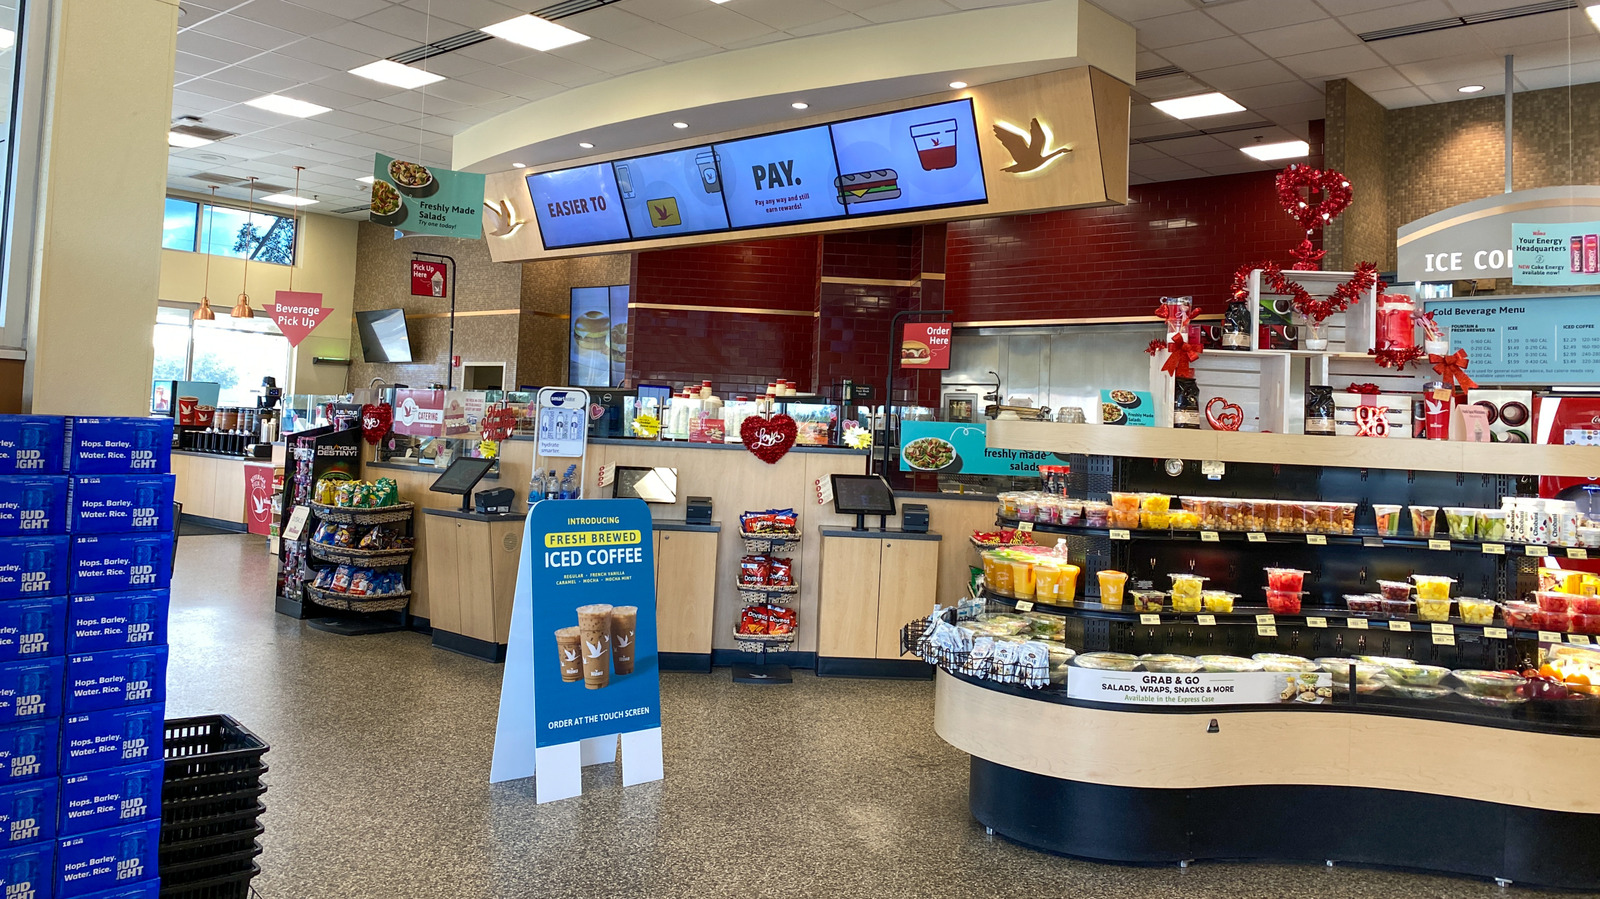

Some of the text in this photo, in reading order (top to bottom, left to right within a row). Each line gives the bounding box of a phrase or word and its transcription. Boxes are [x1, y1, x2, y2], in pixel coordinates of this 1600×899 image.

[751, 159, 802, 191] PAY.
[755, 199, 765, 207] Pay
[776, 196, 787, 204] way
[787, 194, 798, 202] and
[420, 201, 475, 215] Freshly Made
[547, 195, 607, 218] EASIER TO
[777, 203, 802, 213] rewards!
[419, 211, 446, 222] Salads
[439, 221, 457, 230] today!
[1516, 245, 1566, 253] Headquarters
[1424, 252, 1463, 272] ICE
[413, 263, 434, 273] Pick Up
[413, 270, 427, 278] Here
[275, 303, 320, 316] Beverage
[1432, 306, 1526, 317] Cold Beverage Menu
[278, 316, 316, 329] Pick Up
[927, 326, 950, 336] Order
[929, 336, 949, 345] Here
[418, 411, 439, 421] CATERING
[751, 427, 785, 450] Love
[17, 450, 40, 459] BUD
[131, 451, 152, 459] BUD
[984, 448, 1047, 461] freshly made
[1010, 461, 1040, 472] salads
[567, 516, 620, 526] INTRODUCING
[550, 532, 636, 545] FRESH BREWED
[544, 547, 643, 568] ICED COFFEE
[101, 616, 127, 624] Barley.
[748, 611, 768, 621] Doritos
[770, 616, 790, 624] Doritos
[128, 623, 150, 633] BUD
[1142, 675, 1200, 685] GRAB & GO
[1101, 683, 1235, 694] SALADS, WRAPS, SNACKS & MORE
[1124, 694, 1215, 704] Available in the Express Case
[548, 706, 650, 730] ORDER AT THE TOUCH SCREEN
[70, 794, 120, 807] Hops. Barley.
[121, 797, 143, 810] BUD
[68, 810, 95, 818] Water.
